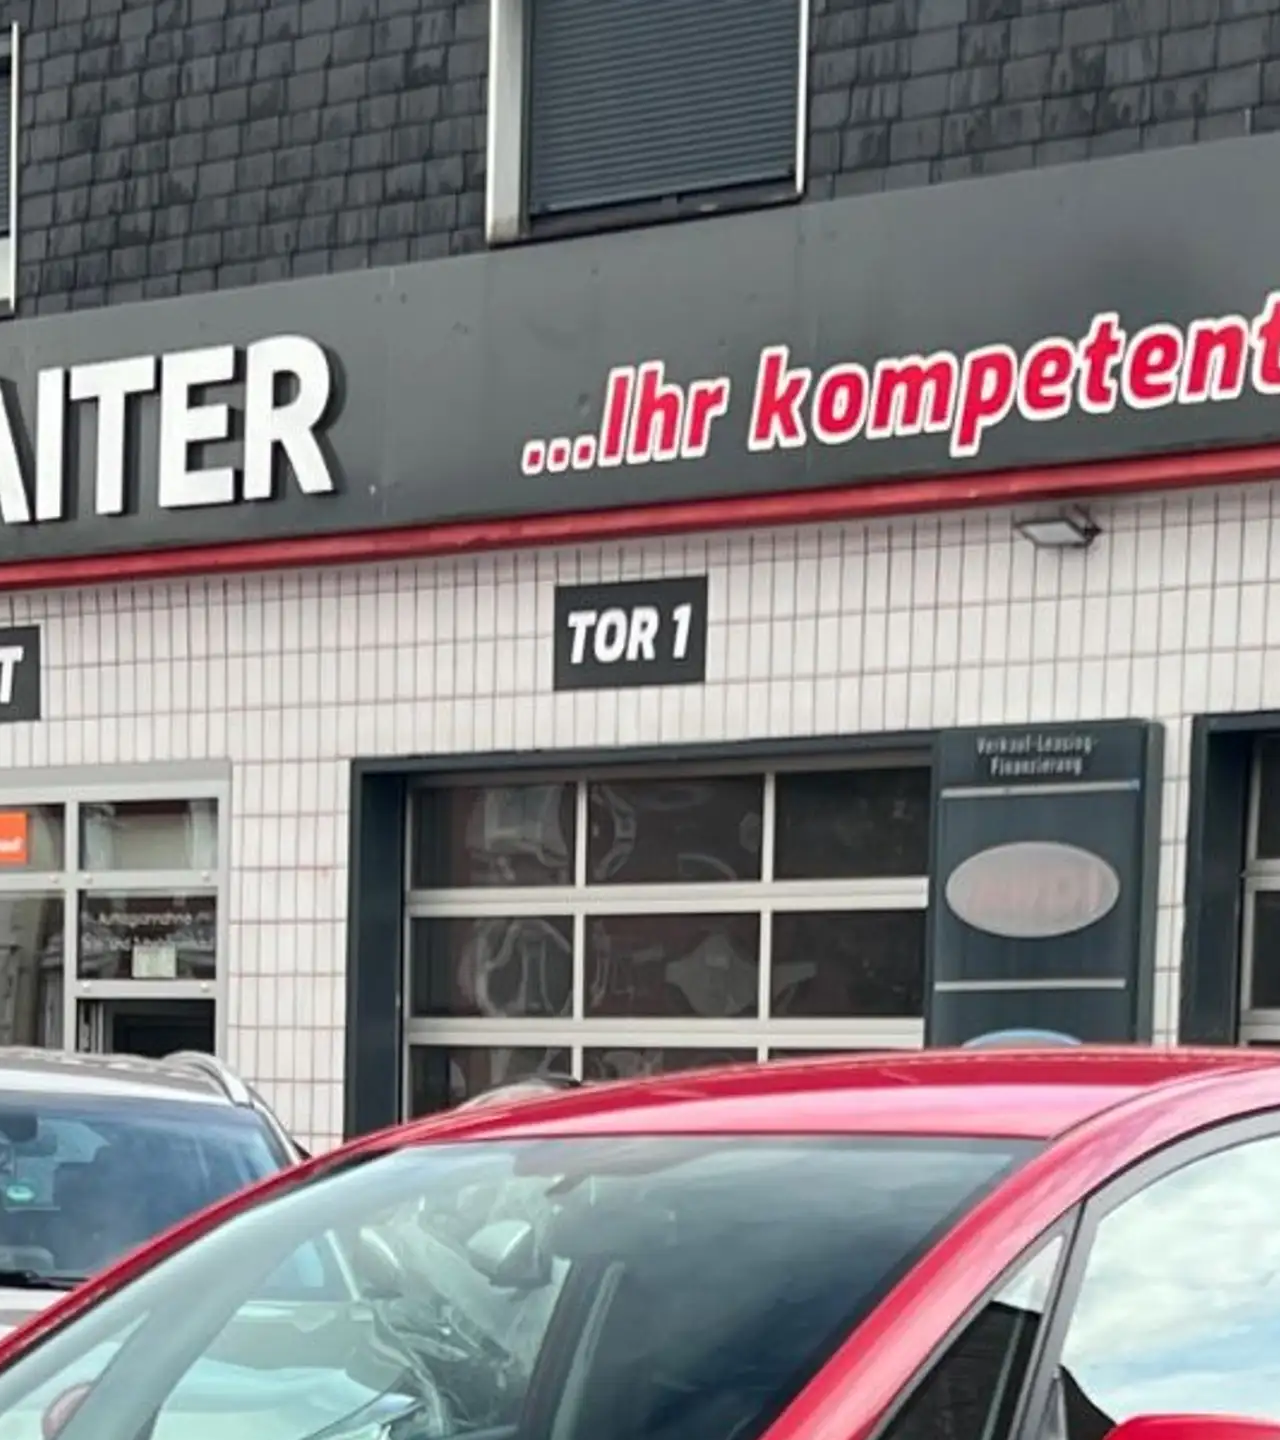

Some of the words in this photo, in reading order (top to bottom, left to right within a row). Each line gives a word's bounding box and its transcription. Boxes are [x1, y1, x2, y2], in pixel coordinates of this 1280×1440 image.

[522, 361, 730, 475] ...Ihr
[566, 608, 658, 664] TOR
[670, 603, 692, 660] 1
